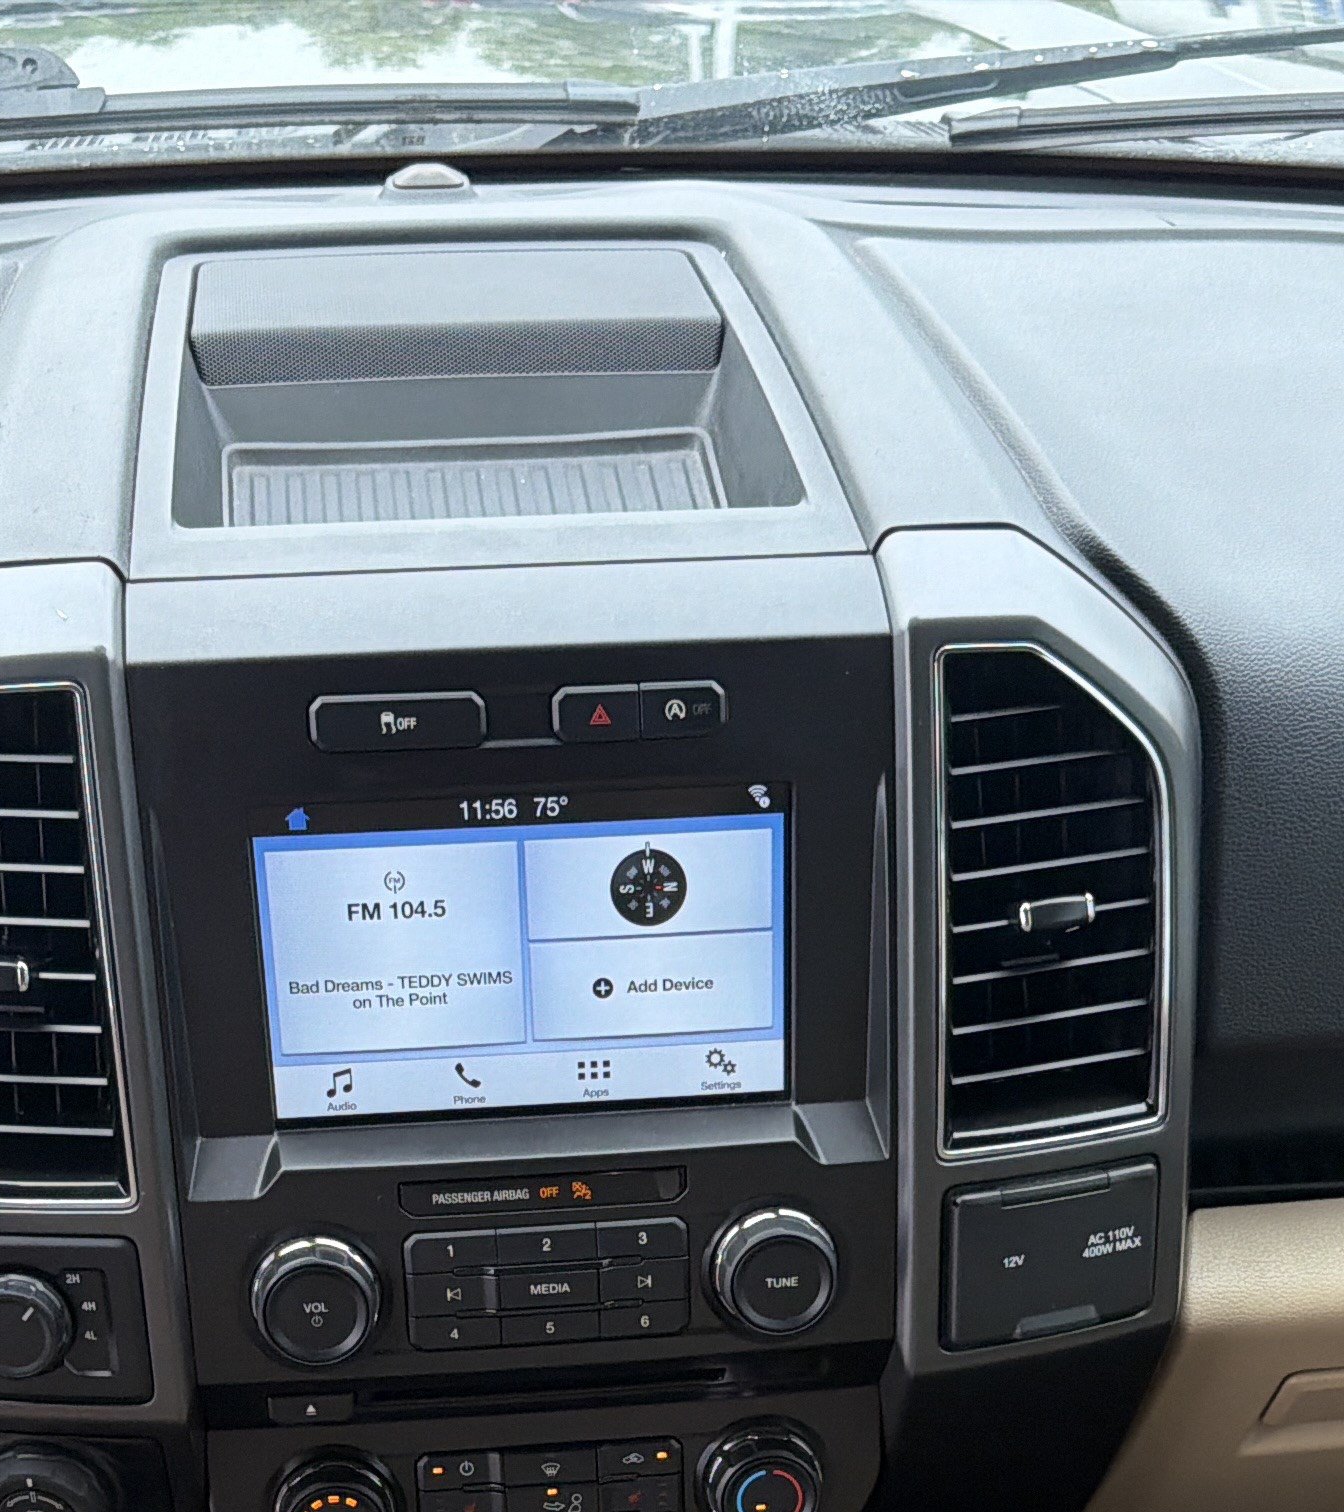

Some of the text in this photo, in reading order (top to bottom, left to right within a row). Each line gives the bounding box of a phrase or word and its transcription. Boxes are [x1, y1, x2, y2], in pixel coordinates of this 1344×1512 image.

[396, 716, 417, 731] OFF
[459, 798, 518, 821] 11:56
[641, 858, 656, 875] W
[346, 899, 447, 922] FM 104.5
[288, 979, 320, 995] Bad
[324, 978, 384, 993] Dreams
[397, 973, 453, 990] TEDDY
[456, 970, 514, 987] SWIMS
[627, 976, 714, 994] Add Device
[352, 991, 448, 1010] on The Point
[700, 1078, 742, 1092] Settings
[452, 1093, 486, 1106] Phone
[582, 1086, 609, 1099] Apps
[327, 1099, 358, 1113] Audio
[431, 1186, 560, 1205] PASSENGER AIRBAG OFF
[637, 1231, 648, 1245] 3
[1087, 1225, 1135, 1246] AC 110V
[446, 1244, 455, 1258] 1
[542, 1237, 552, 1252] 2
[1082, 1235, 1142, 1259] 400W MAX
[1002, 1253, 1026, 1269] 12V
[65, 1273, 81, 1285] 2H
[764, 1276, 799, 1289] TUNE
[529, 1282, 571, 1296] MEDIA
[81, 1301, 97, 1312] 4H
[302, 1302, 329, 1314] VOL
[545, 1321, 556, 1334] 5
[640, 1315, 651, 1328] 6
[84, 1330, 98, 1341] 4L
[450, 1328, 460, 1341] 4
